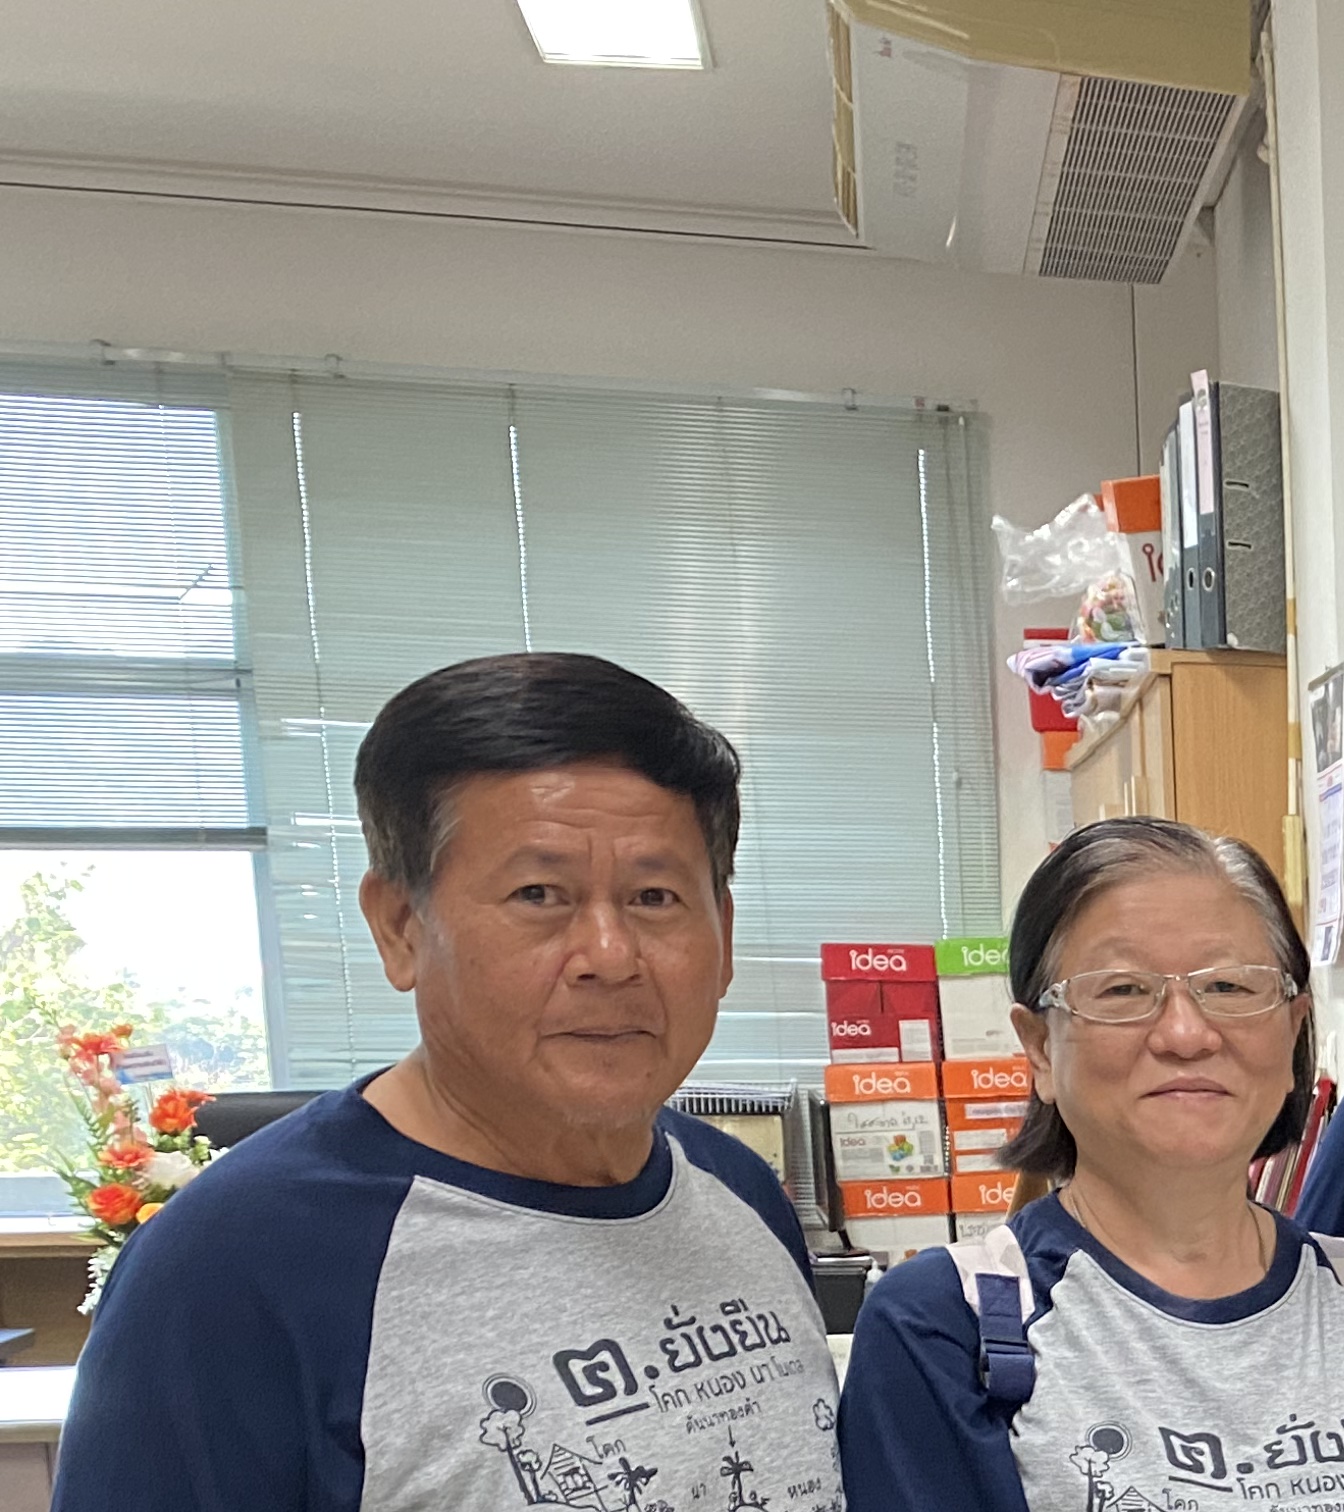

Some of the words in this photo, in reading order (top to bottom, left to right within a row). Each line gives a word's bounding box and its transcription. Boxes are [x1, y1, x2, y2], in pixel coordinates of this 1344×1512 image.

[849, 947, 907, 972] idea
[831, 1020, 872, 1037] idea
[853, 1070, 912, 1096] idea
[971, 1067, 1028, 1089] idea
[864, 1186, 923, 1209] idea
[979, 1182, 1015, 1205] ide
[649, 1383, 692, 1413] โคก
[694, 1370, 747, 1403] หนอง
[750, 1362, 776, 1384] นา
[585, 1434, 627, 1460] โคก
[691, 1482, 707, 1500] นา
[1161, 1487, 1200, 1511] โคก
[1236, 1477, 1281, 1500] โคก
